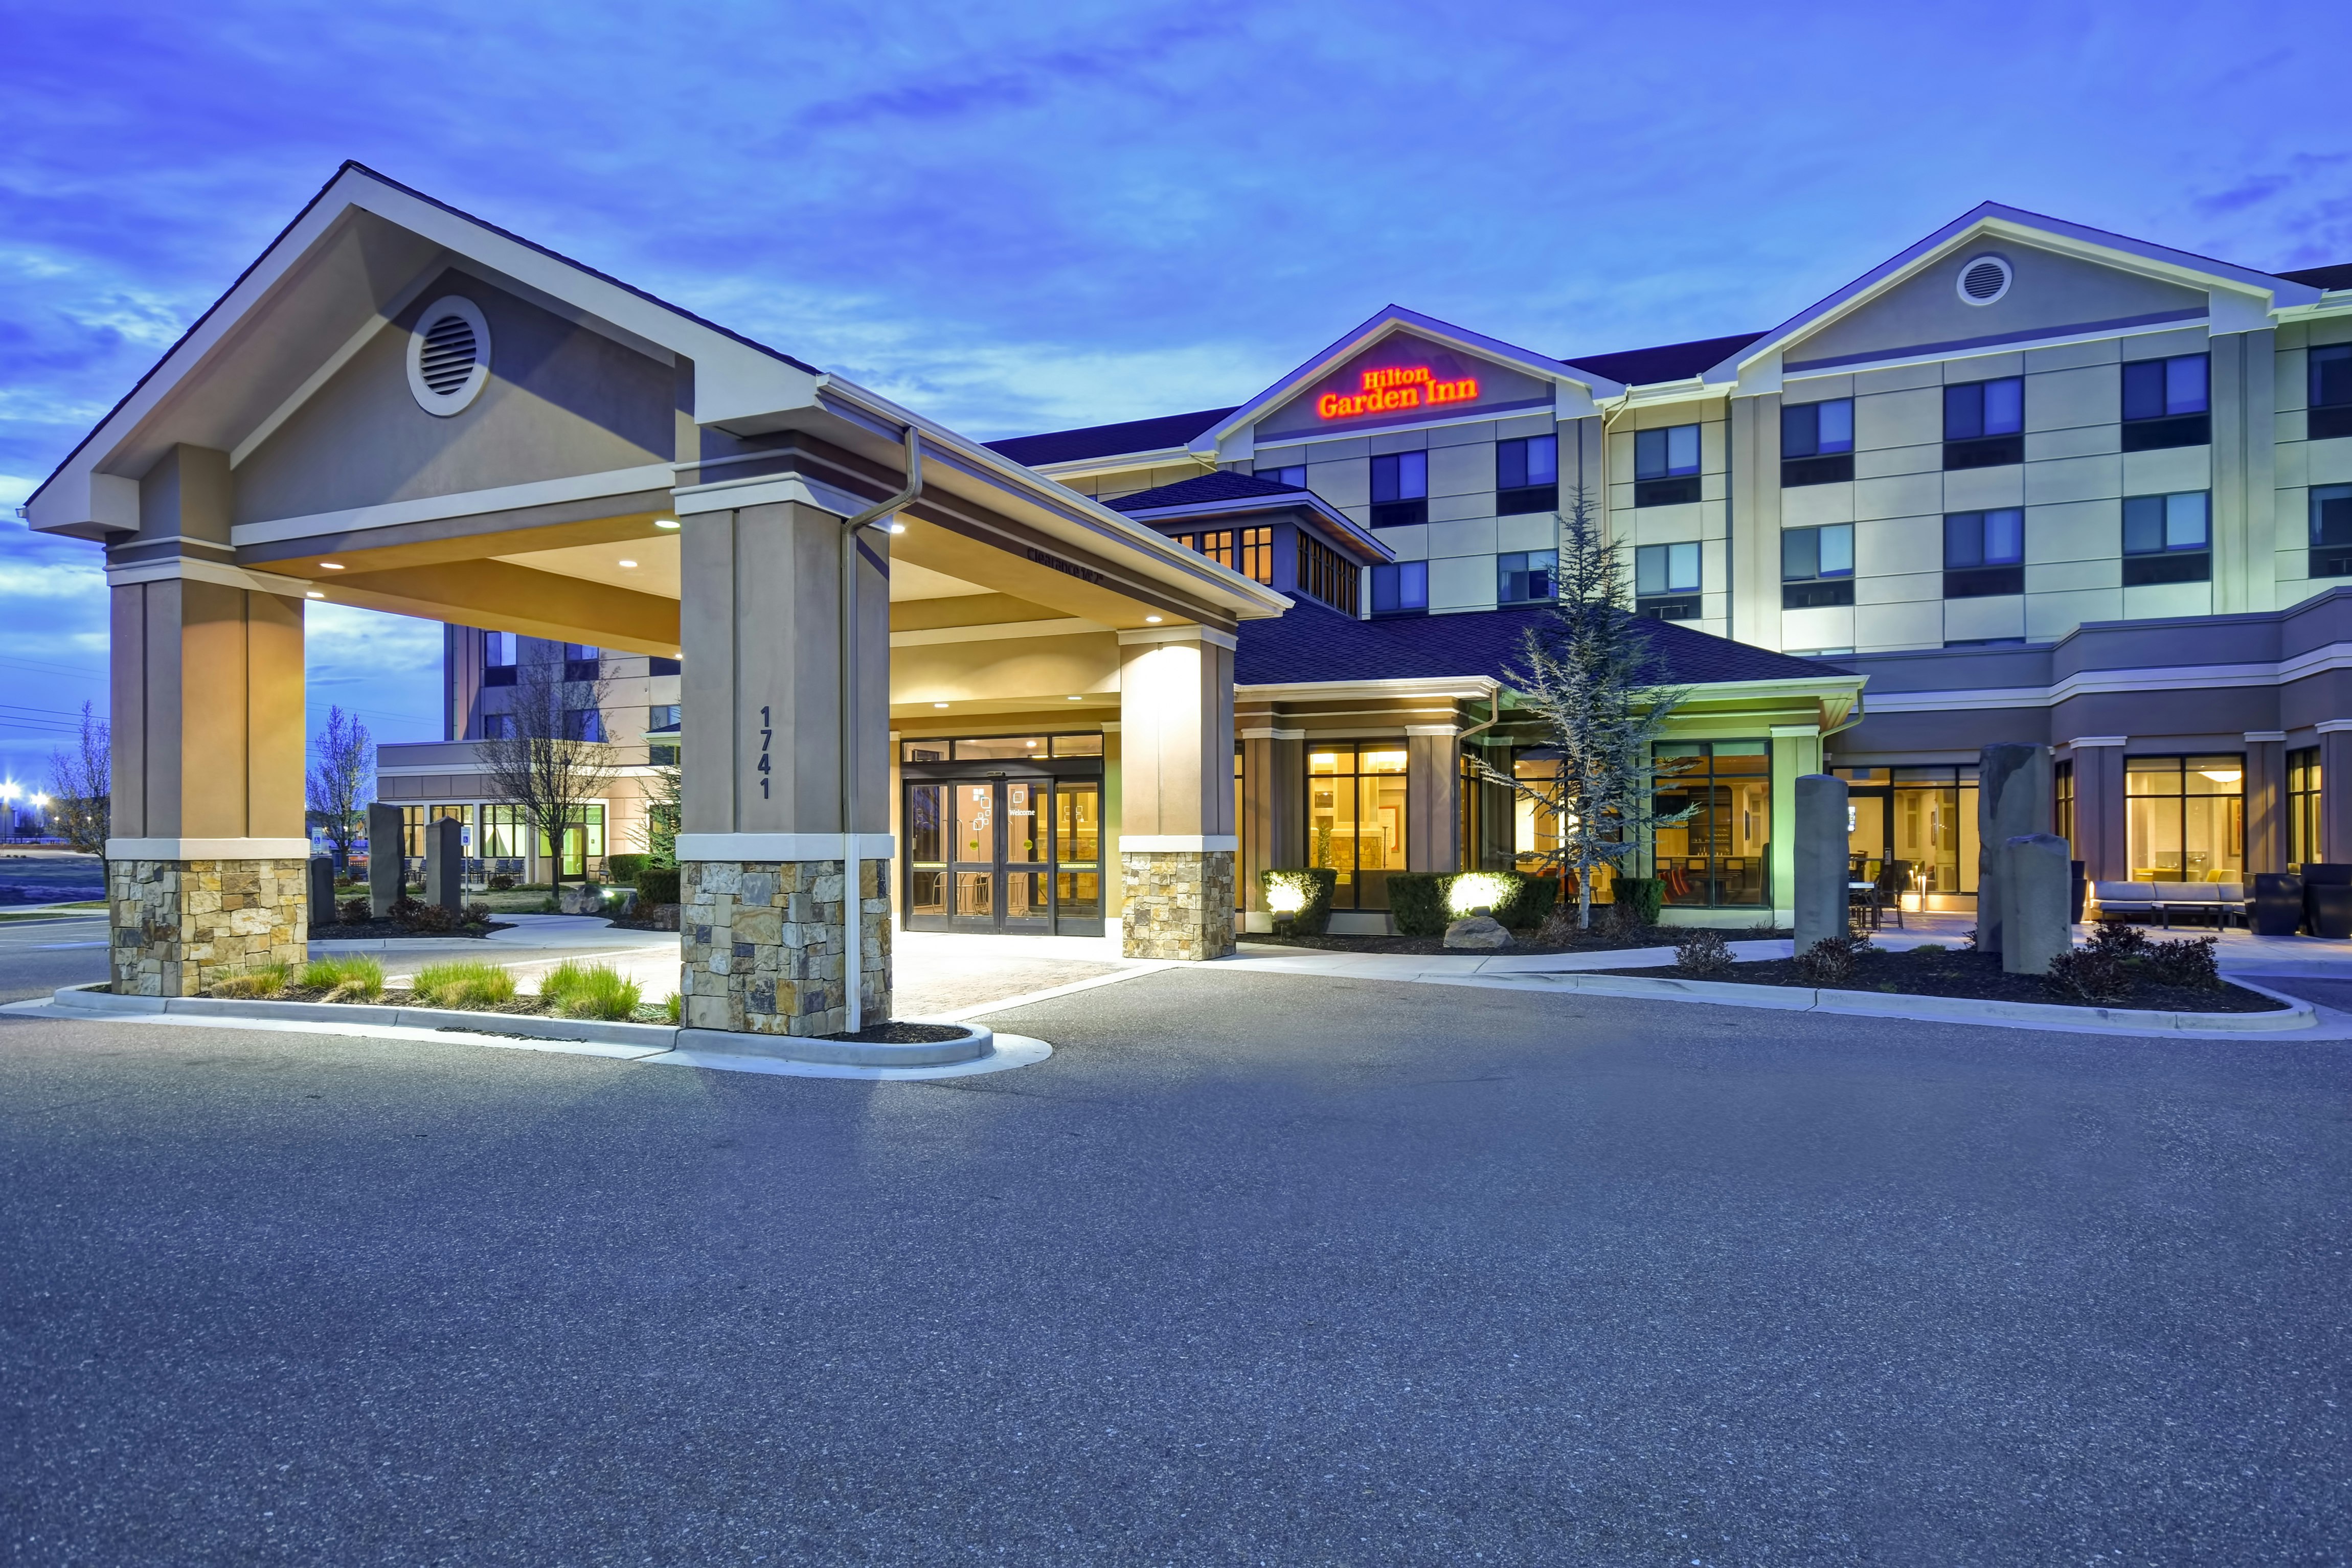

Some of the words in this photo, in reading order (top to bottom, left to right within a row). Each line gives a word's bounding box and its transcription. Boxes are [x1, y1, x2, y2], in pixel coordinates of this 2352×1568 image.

[1362, 367, 1430, 391] Hilton
[1318, 387, 1420, 419] Garden
[1424, 377, 1478, 404] Inn
[1027, 548, 1079, 577] Clearance
[757, 706, 772, 799] 1741
